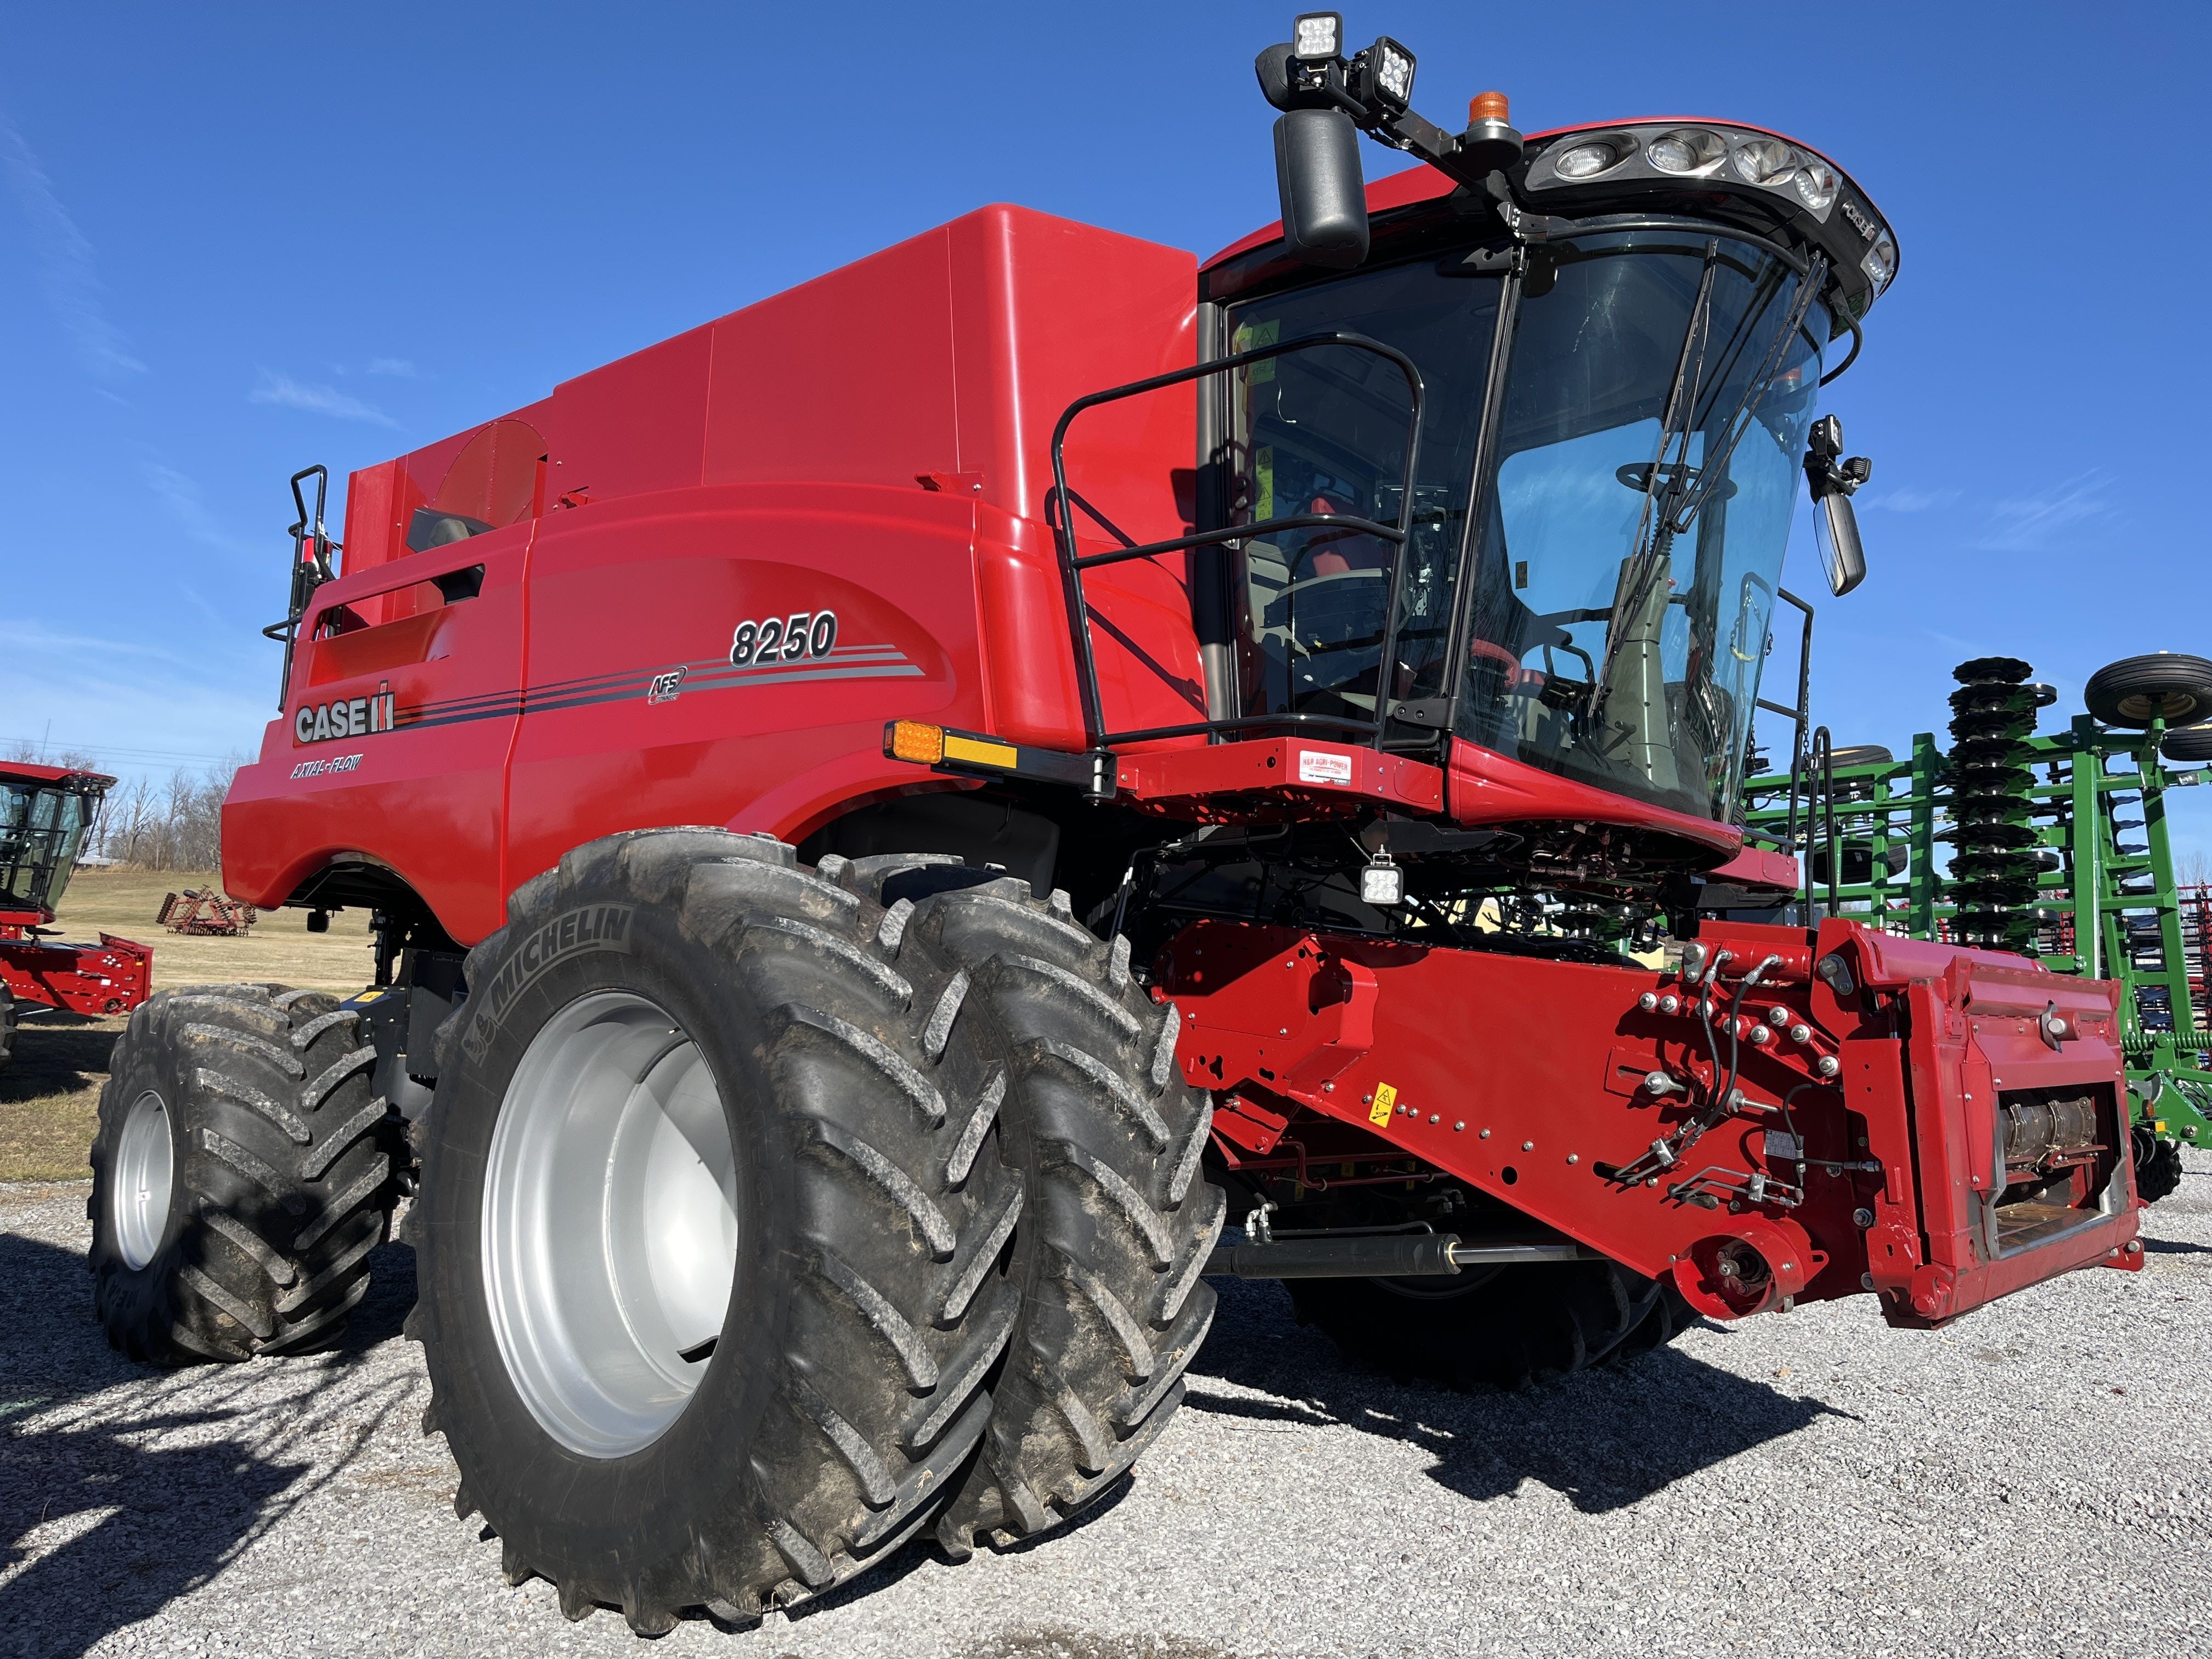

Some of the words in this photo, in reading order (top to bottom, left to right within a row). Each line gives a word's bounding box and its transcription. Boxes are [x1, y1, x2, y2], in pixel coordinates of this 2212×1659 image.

[730, 610, 838, 668] 8250
[648, 672, 679, 696] AFS
[296, 697, 367, 743] CASE
[290, 754, 363, 779] AXIAL-FLOW
[1316, 758, 1348, 771] AGRI-POWER
[490, 907, 631, 1016] MICHELIN
